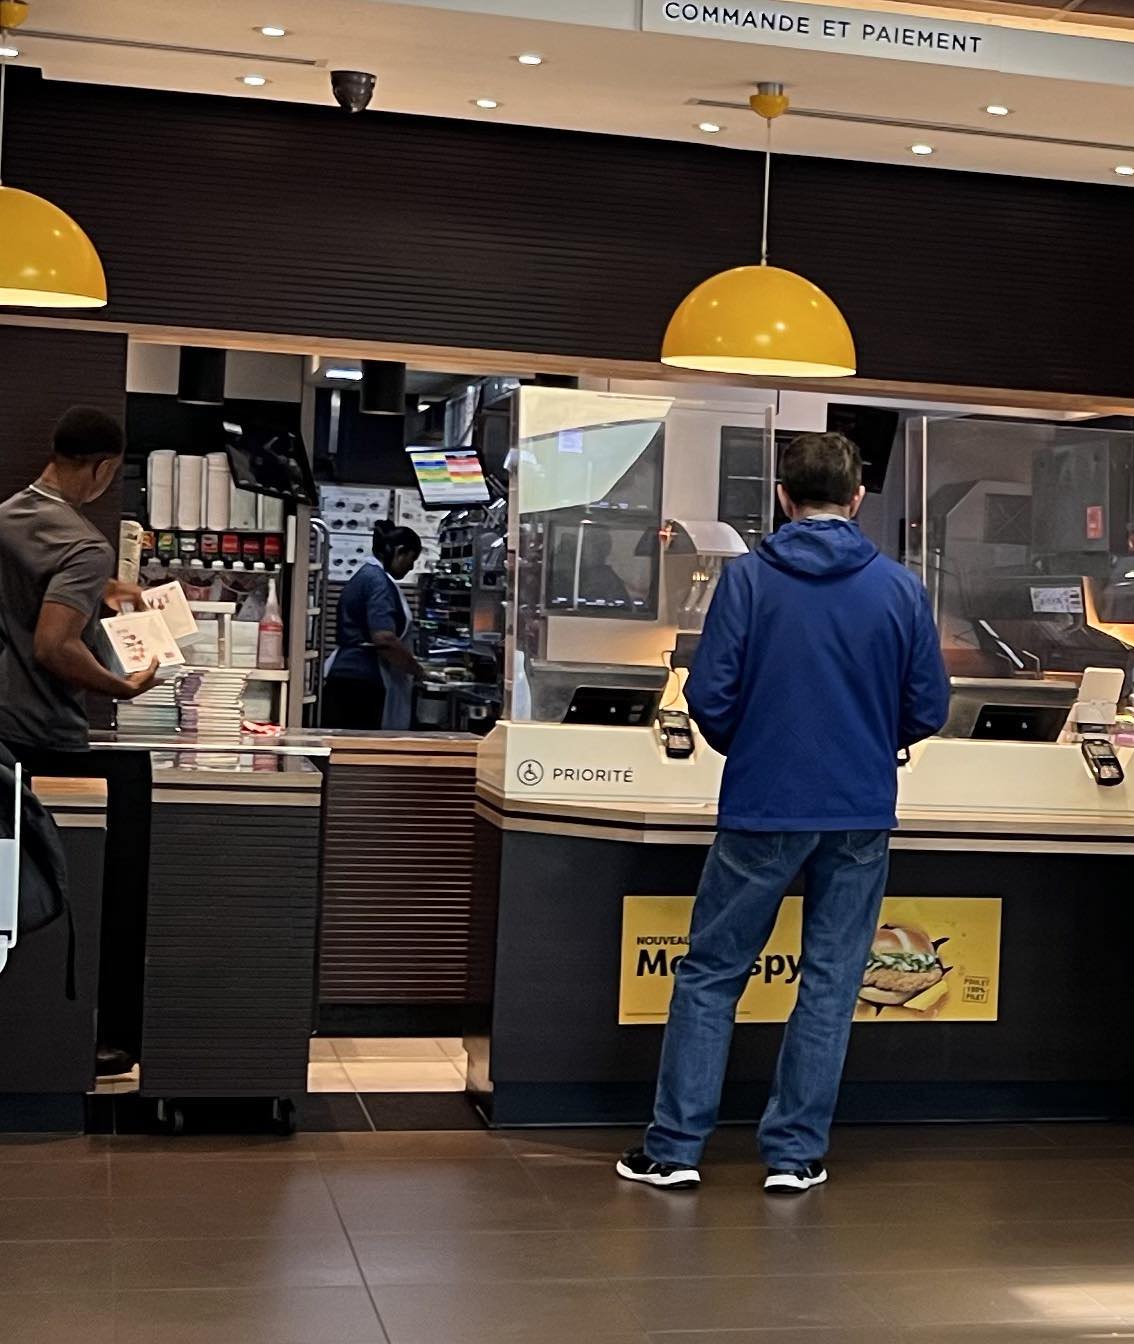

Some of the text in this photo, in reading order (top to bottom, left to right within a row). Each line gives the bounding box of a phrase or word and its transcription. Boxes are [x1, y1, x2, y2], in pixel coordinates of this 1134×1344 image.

[664, 2, 983, 53] COMMANDE ET PAIEMENT
[552, 766, 634, 783] PRIORITÉ
